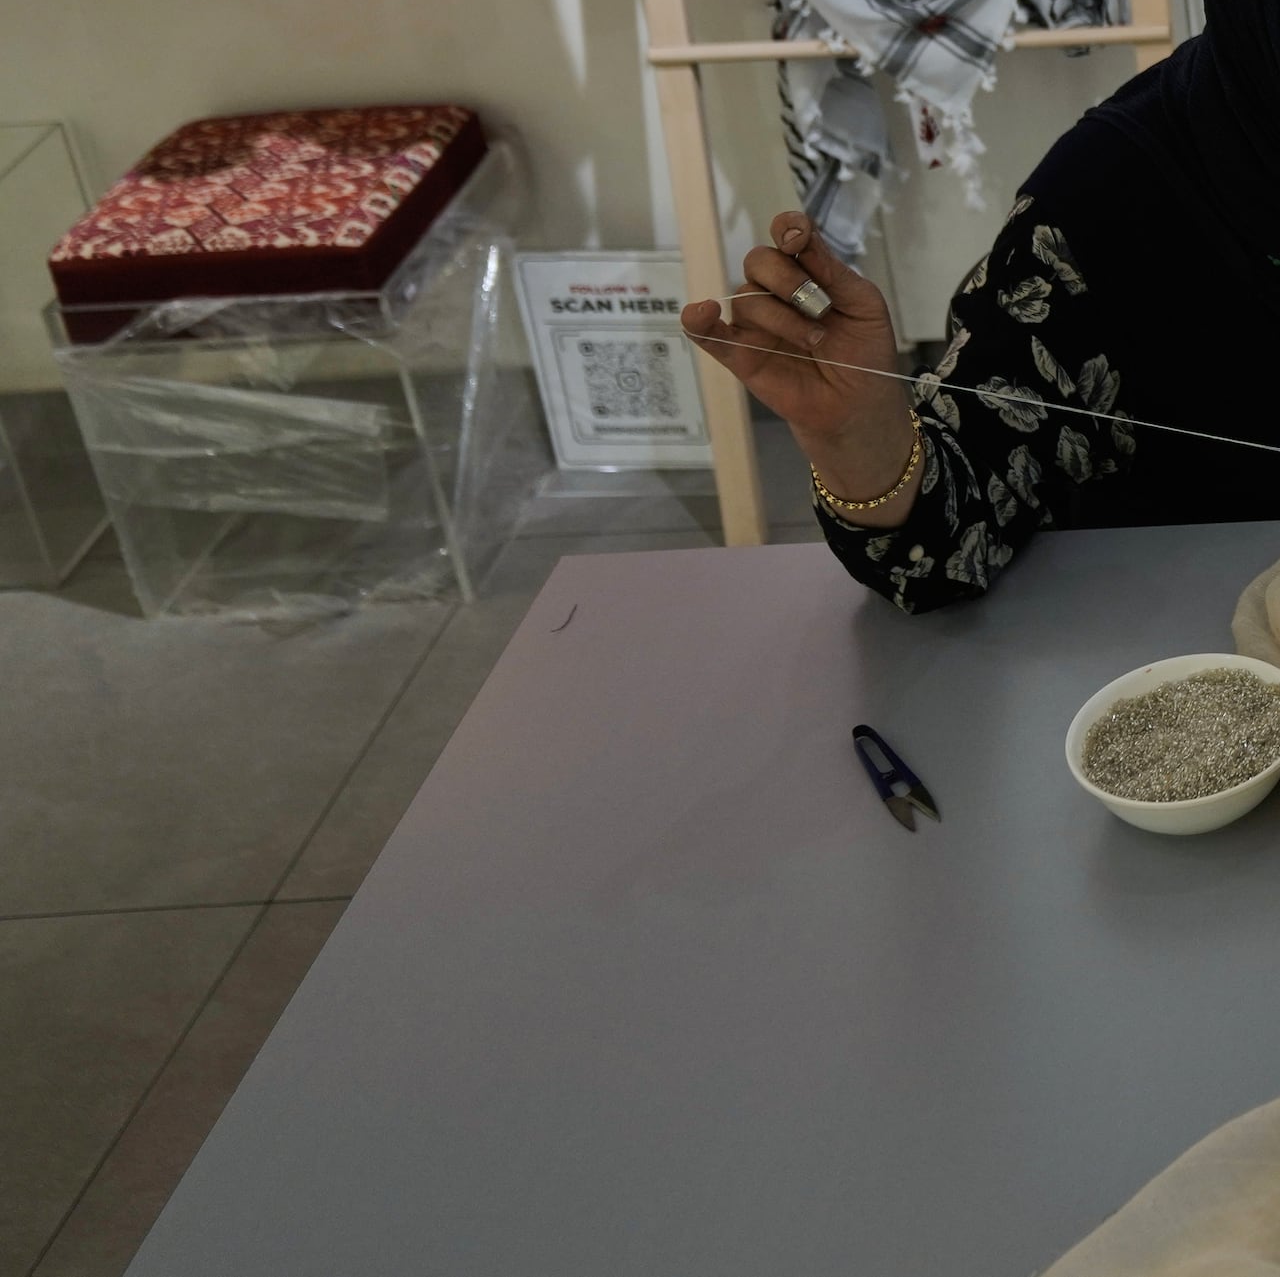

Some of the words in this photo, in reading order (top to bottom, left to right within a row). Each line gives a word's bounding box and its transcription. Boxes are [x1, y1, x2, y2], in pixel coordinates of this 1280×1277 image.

[569, 284, 627, 294] FOLLOW
[551, 298, 612, 313] SCAN
[620, 298, 680, 314] HERE
